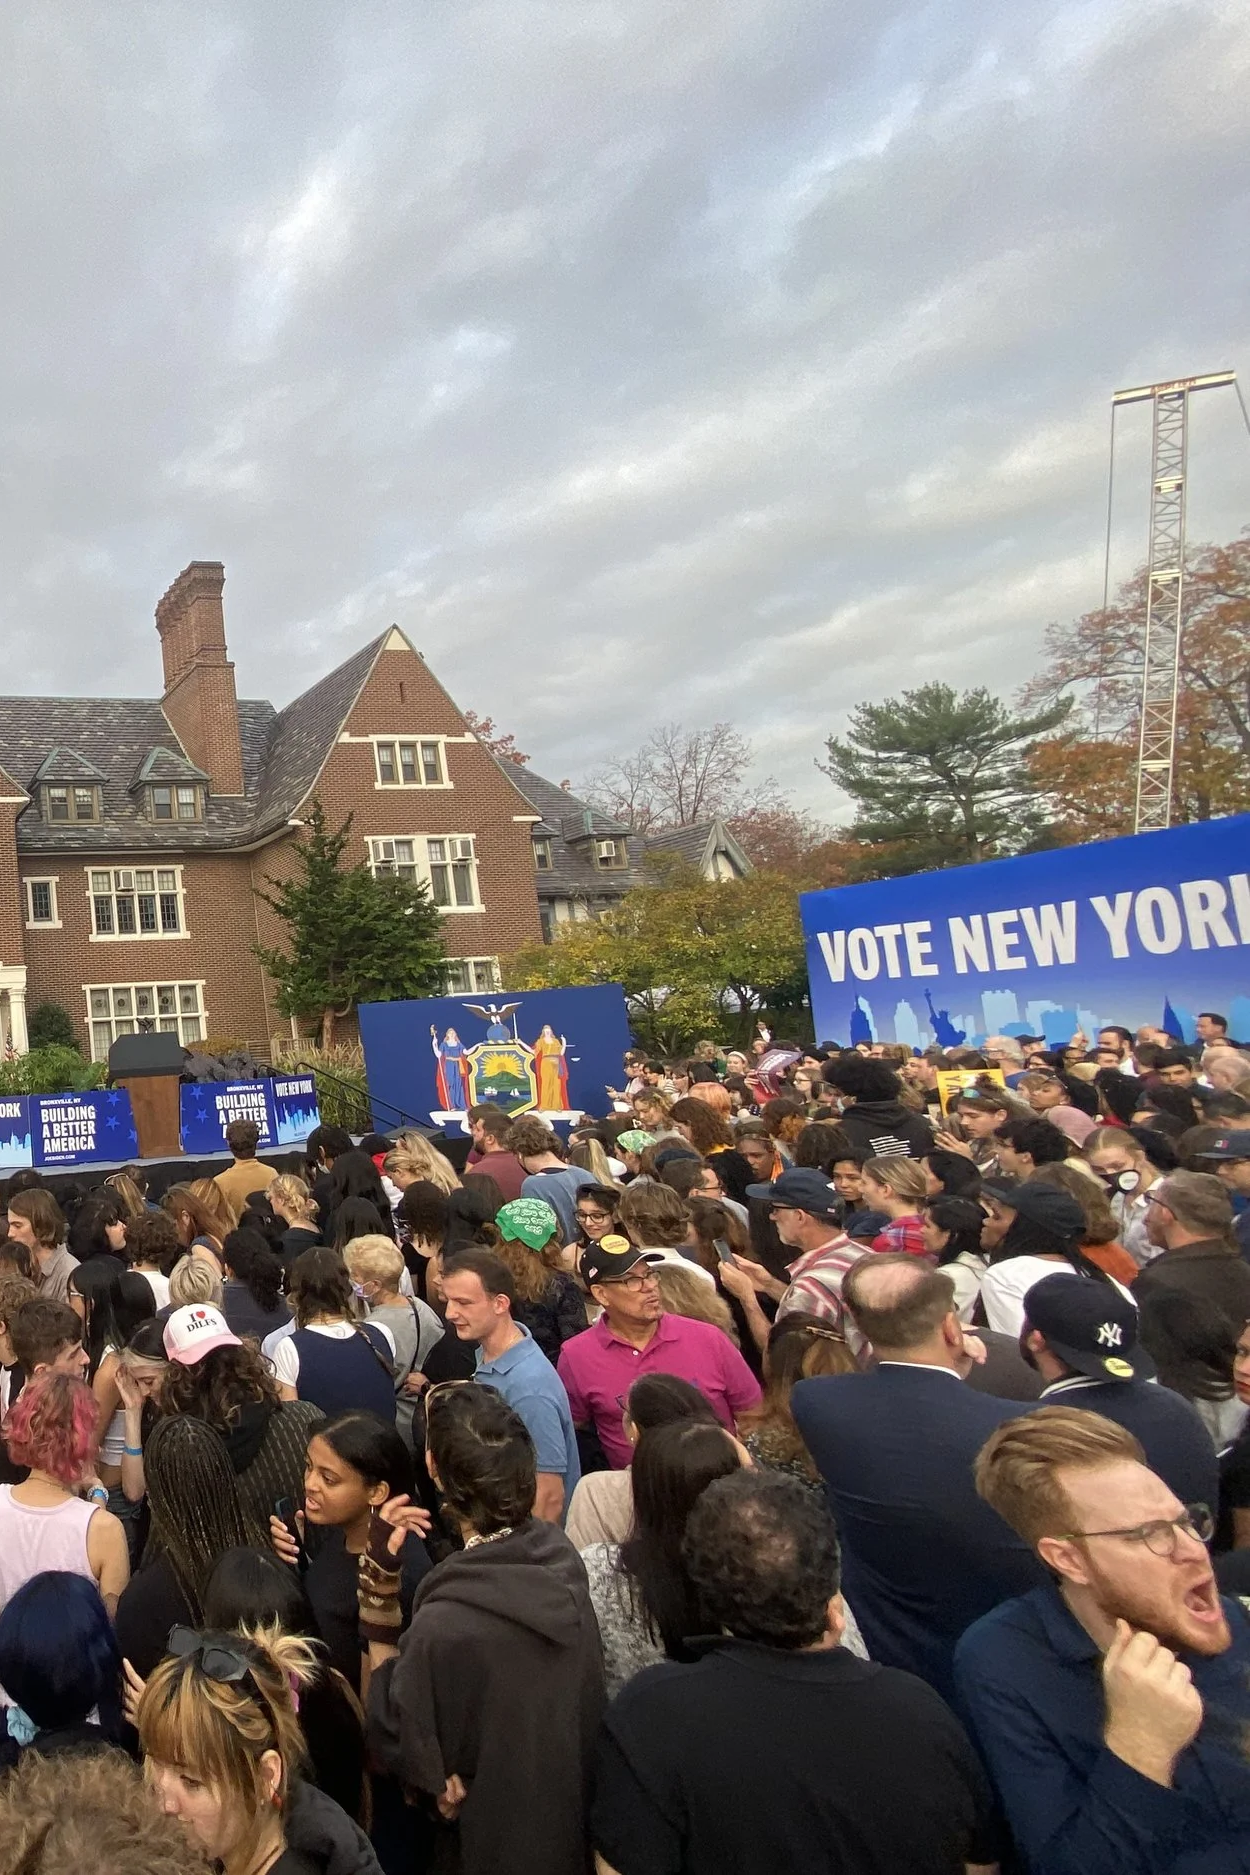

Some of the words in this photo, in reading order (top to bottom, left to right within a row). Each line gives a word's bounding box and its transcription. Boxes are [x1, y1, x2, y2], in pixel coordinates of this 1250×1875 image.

[817, 920, 939, 983] VOTE
[948, 900, 1077, 974] NEW
[275, 1082, 289, 1097] VOTE
[289, 1081, 299, 1096] NEW
[299, 1079, 313, 1095] YORK
[215, 1093, 266, 1110] BUILDING
[40, 1105, 96, 1123] BUILDING
[219, 1110, 227, 1124] A
[228, 1107, 268, 1123] BETTER
[42, 1123, 51, 1138] A
[52, 1120, 96, 1138] BETTER
[43, 1135, 96, 1153] AMERICA
[186, 1318, 217, 1332] DILFS
[189, 1312, 196, 1322] I
[1097, 1322, 1123, 1348] NY
